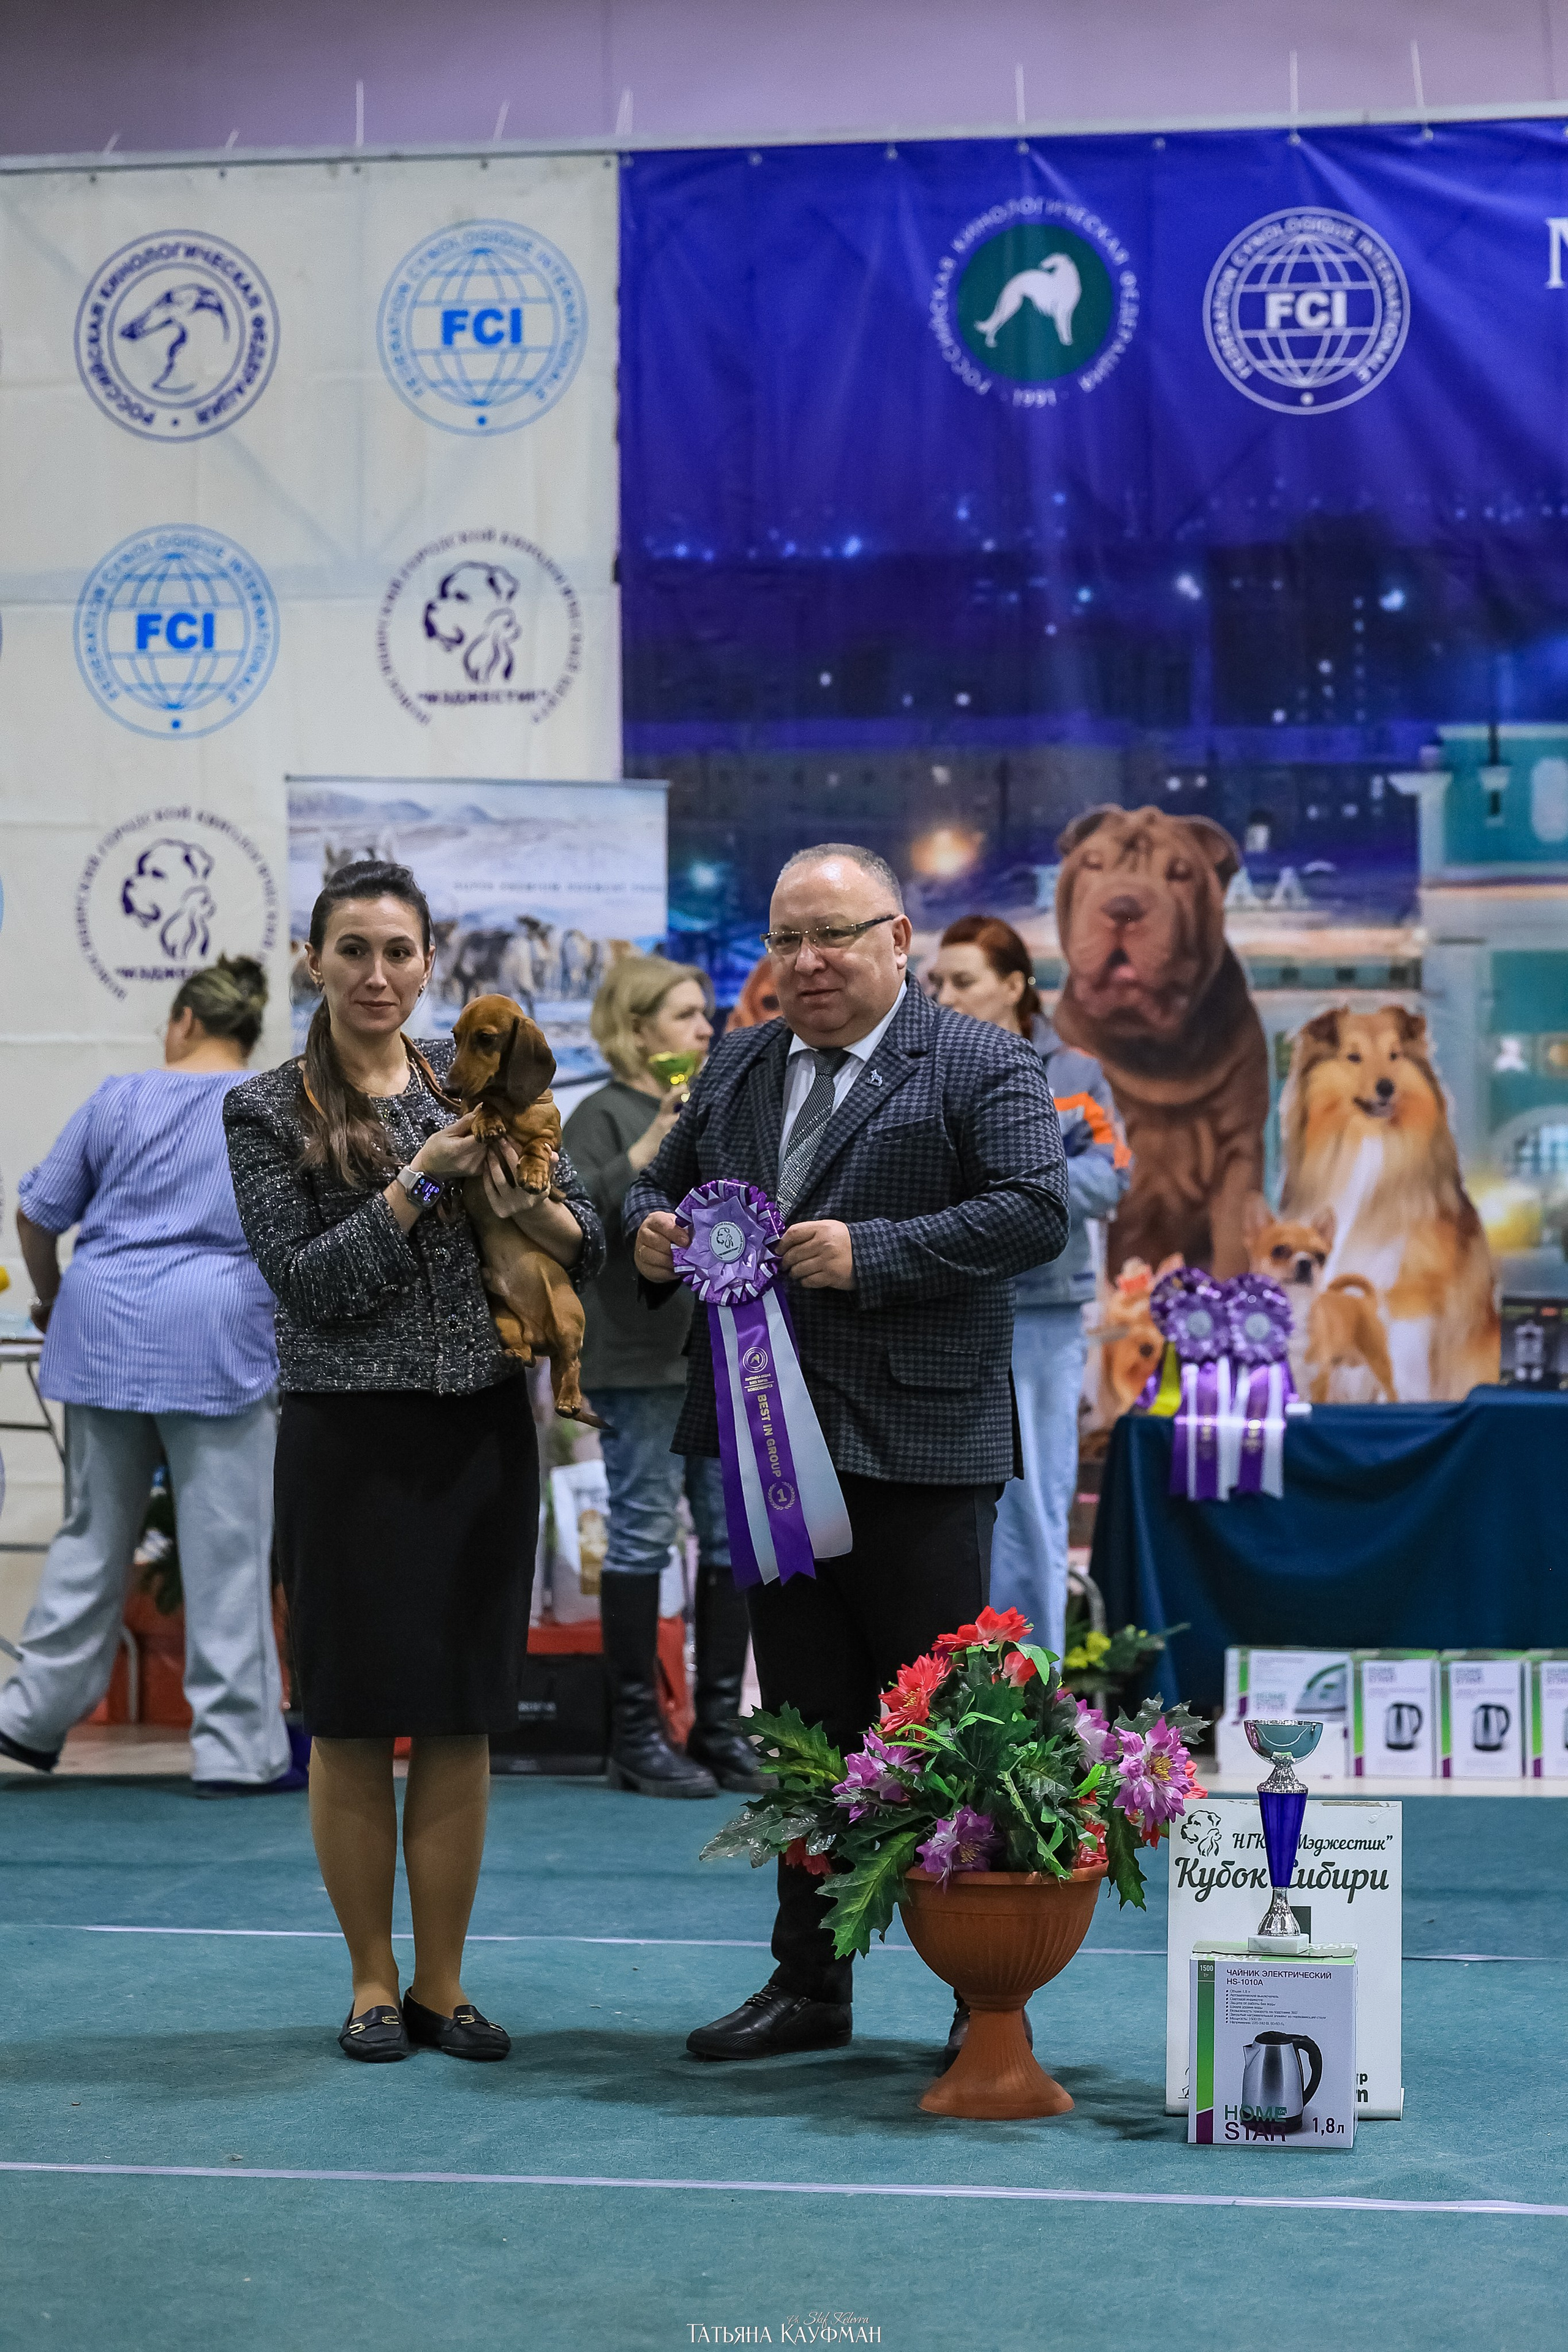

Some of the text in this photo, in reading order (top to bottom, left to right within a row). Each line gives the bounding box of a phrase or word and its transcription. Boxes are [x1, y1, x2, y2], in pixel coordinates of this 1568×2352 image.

[1265, 291, 1348, 328] FCI
[442, 307, 522, 346] FCI
[1012, 388, 1057, 407] 1991
[137, 612, 214, 650] FCI
[757, 1394, 782, 1477] BEST IN GROUP
[777, 1488, 787, 1502] 1
[1175, 1856, 1268, 1902] Кубок
[1226, 1969, 1332, 1980] ЧАЙНИК ЭЛЕКТРИЧЕСКИЙ
[1224, 2104, 1287, 2122] HOME
[1224, 2122, 1286, 2142] STAR
